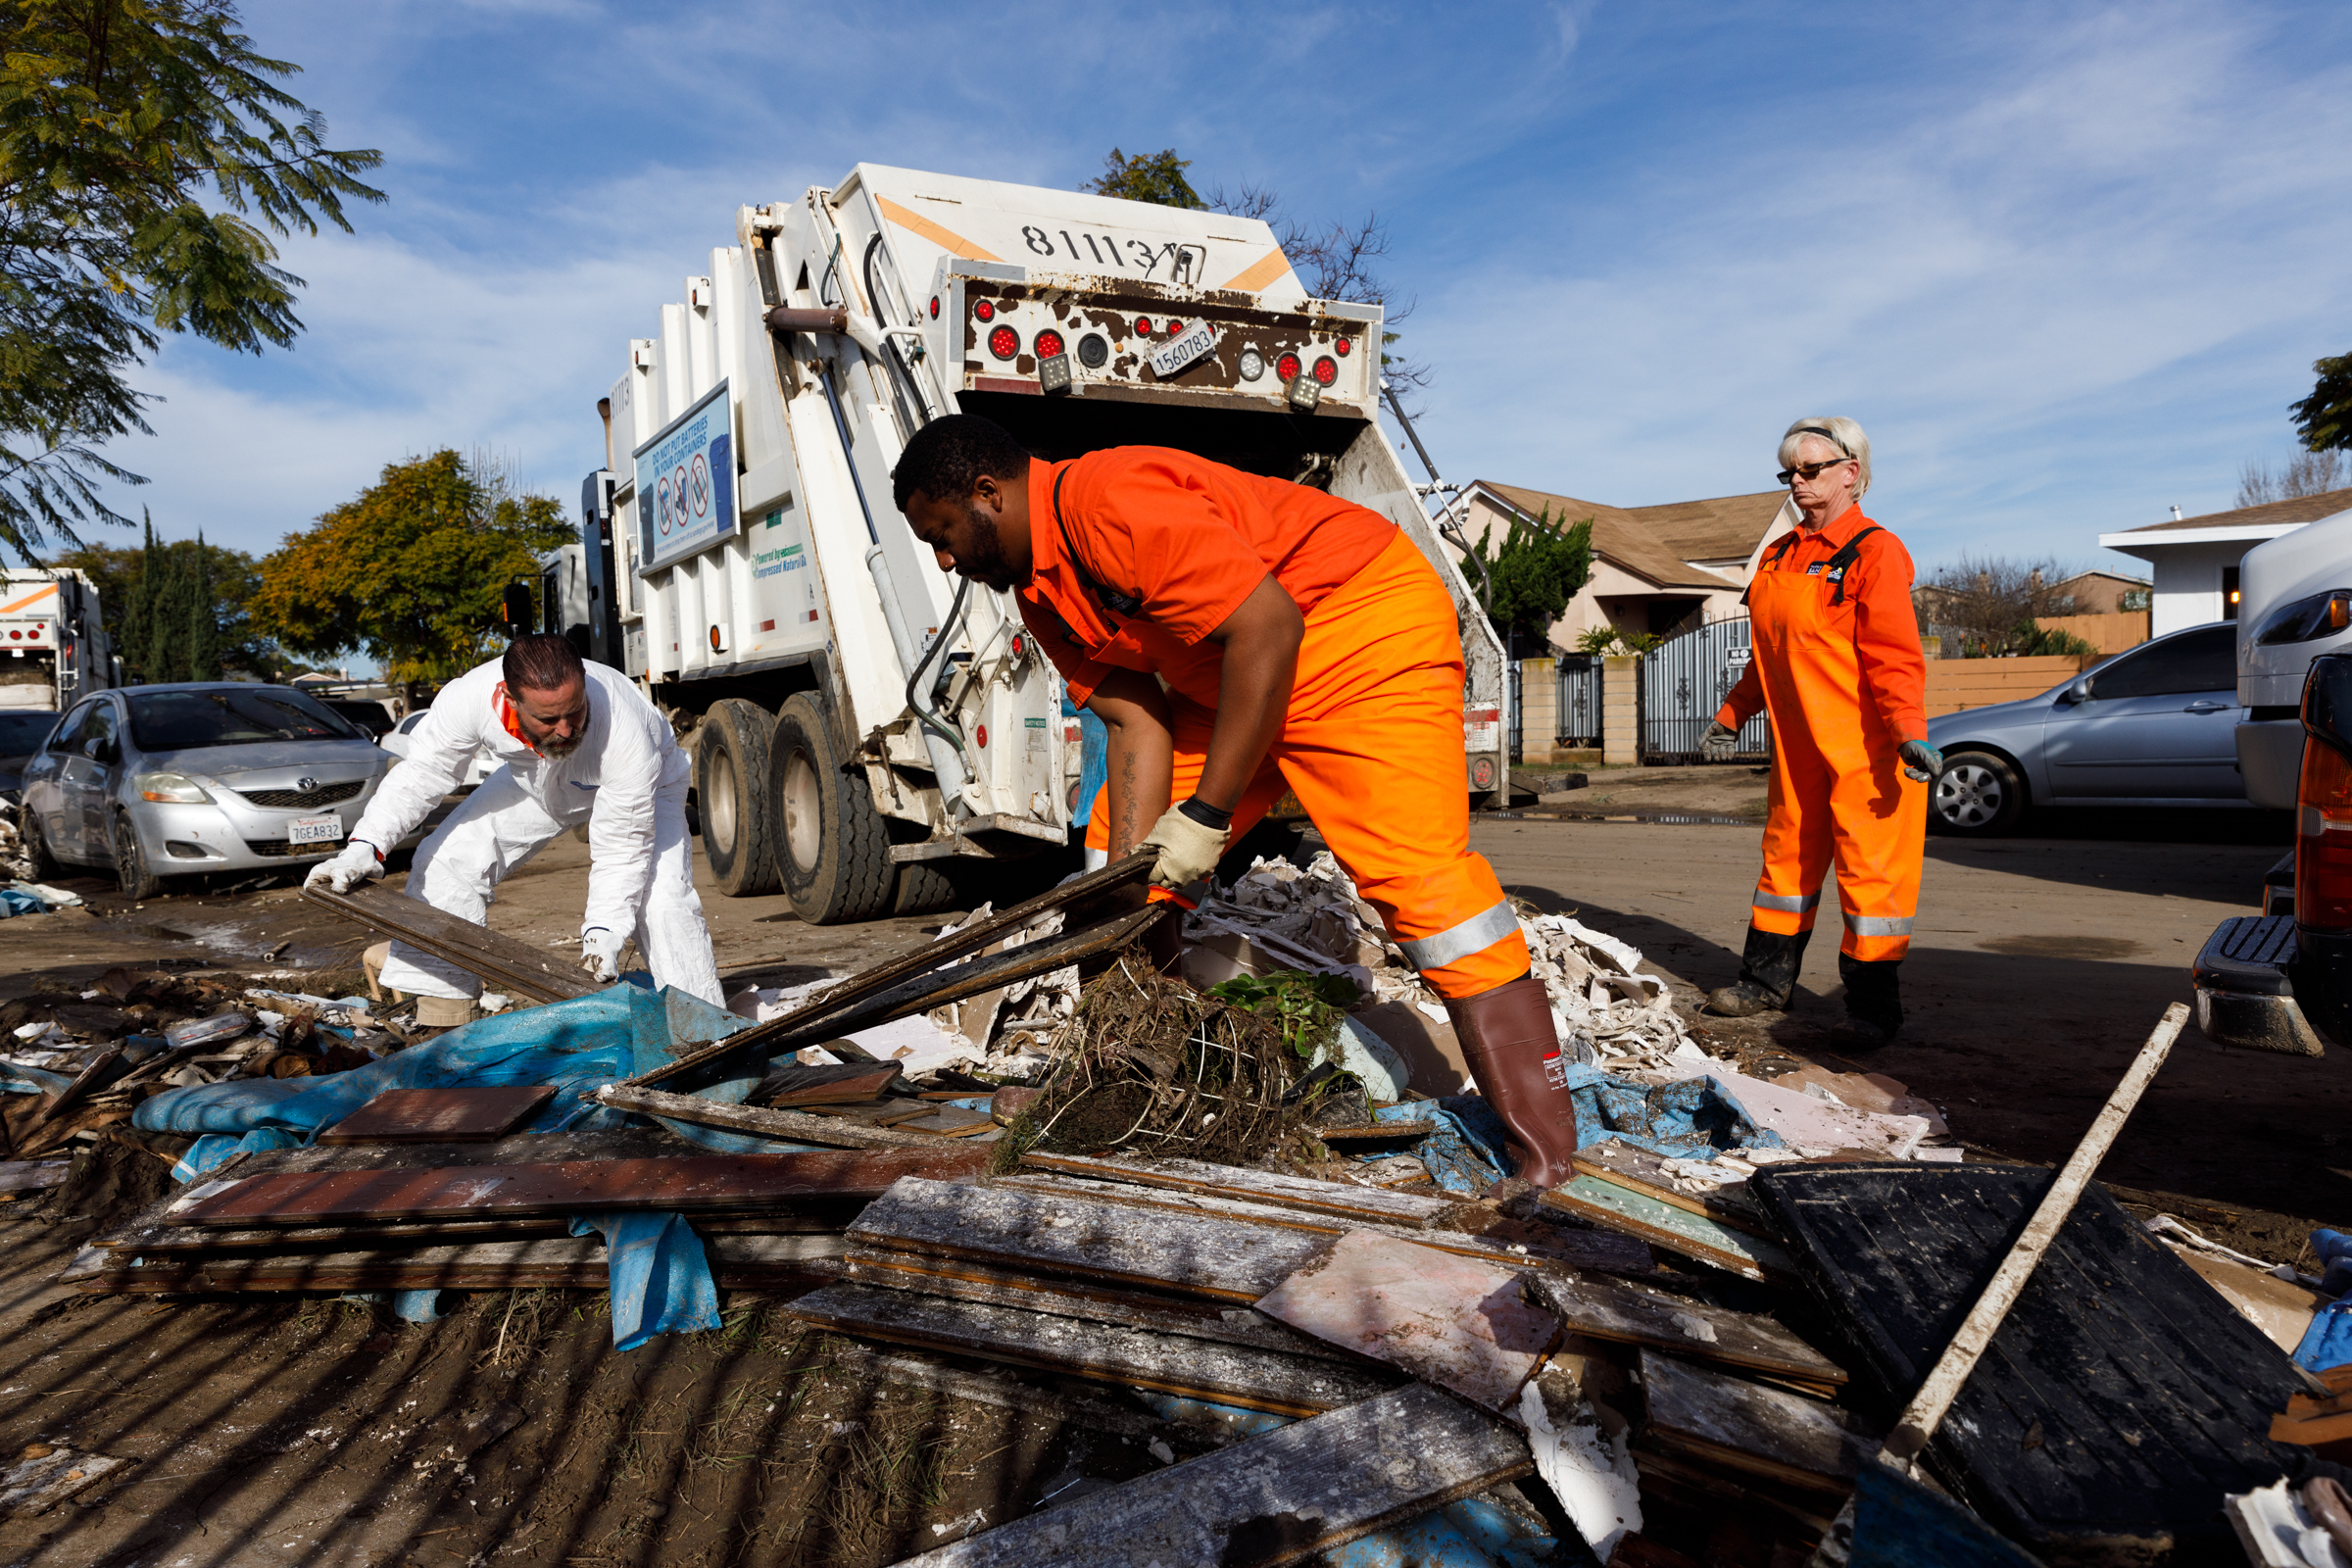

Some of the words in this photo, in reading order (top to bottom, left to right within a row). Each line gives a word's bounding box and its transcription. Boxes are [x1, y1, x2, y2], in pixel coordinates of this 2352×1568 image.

[1170, 328, 1192, 345] EXEMPT
[1156, 330, 1210, 370] 1560783
[653, 451, 660, 466] DO
[661, 442, 670, 461] NOT
[671, 435, 680, 452] PUT
[681, 415, 708, 445] BATTERIES
[655, 466, 660, 478] IN
[661, 455, 674, 473] YOUR
[674, 431, 708, 465] CONTAINERS
[756, 561, 782, 579] Compressed
[783, 555, 801, 572] Natural
[757, 549, 773, 564] Powered
[774, 548, 781, 562] by
[293, 824, 339, 840] 7GEA832
